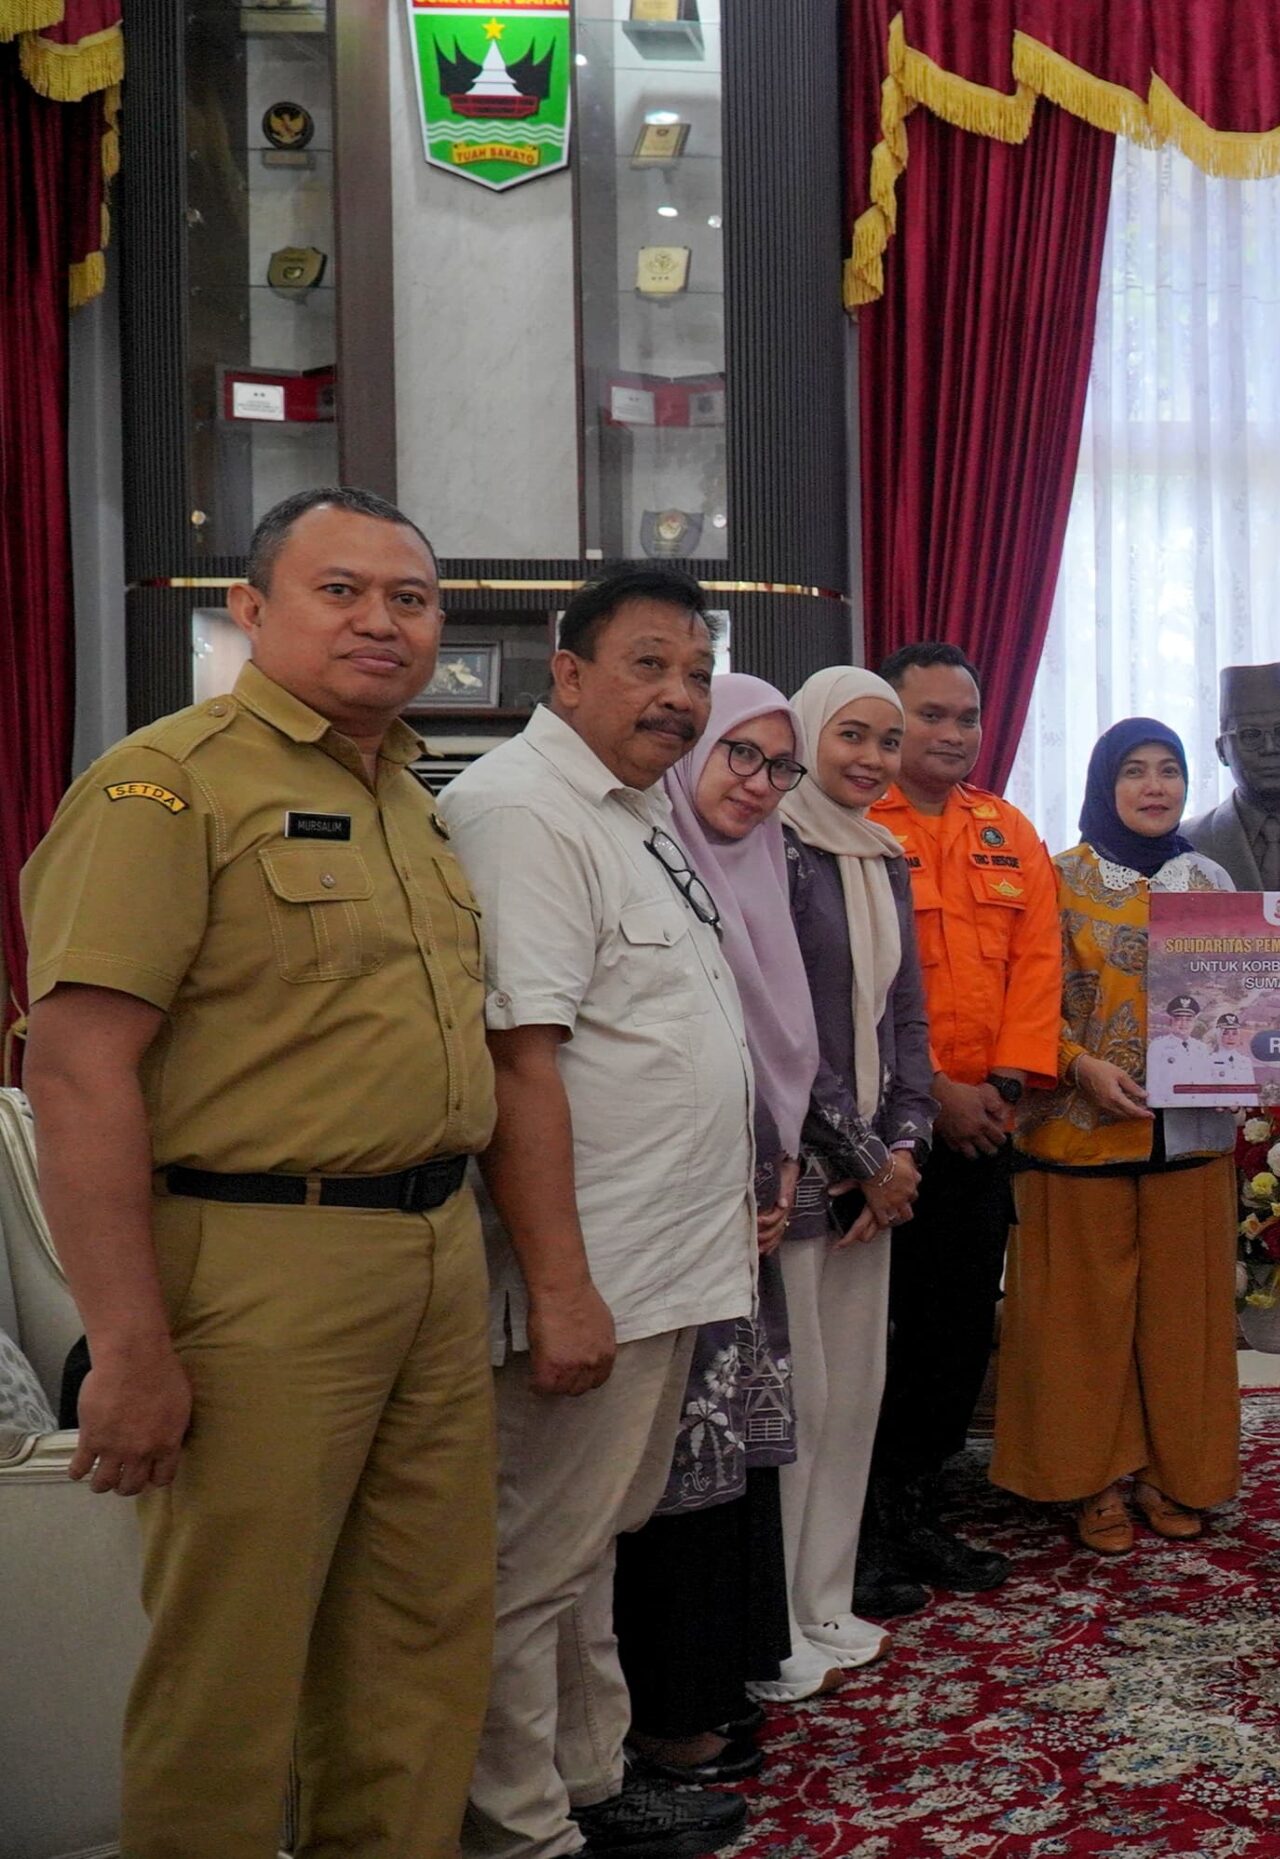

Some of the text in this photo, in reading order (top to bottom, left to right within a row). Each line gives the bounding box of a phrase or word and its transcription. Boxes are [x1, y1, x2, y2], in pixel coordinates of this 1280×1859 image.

[115, 784, 176, 807] SETDA
[1165, 937, 1252, 953] SOLIDARITAS
[1189, 960, 1239, 973] UNTUK
